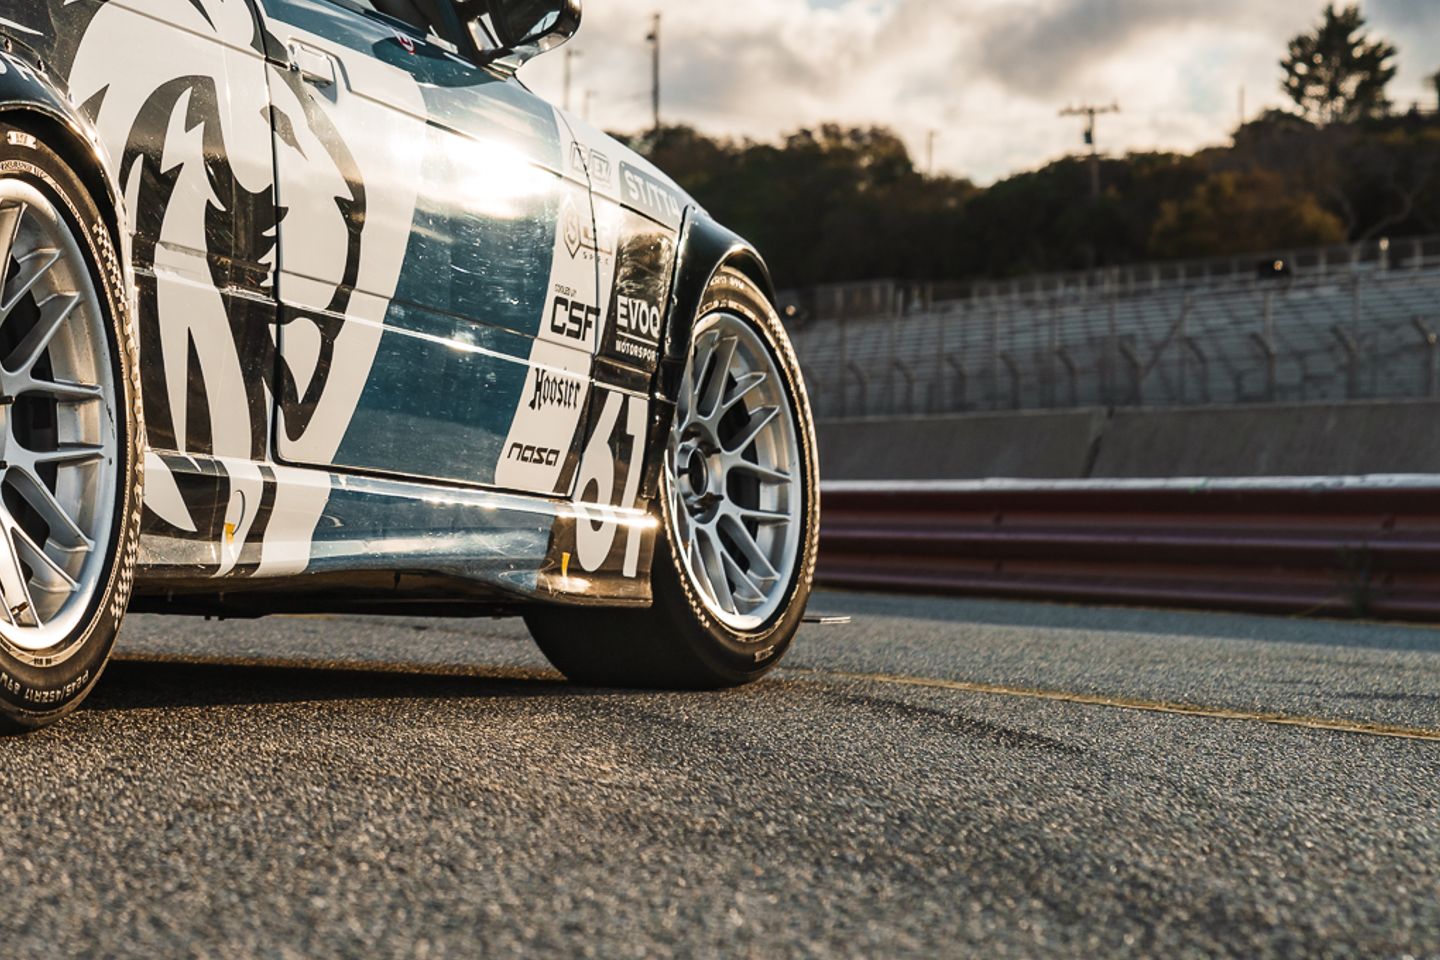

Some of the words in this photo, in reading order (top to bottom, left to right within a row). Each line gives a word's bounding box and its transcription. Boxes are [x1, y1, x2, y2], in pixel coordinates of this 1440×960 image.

[551, 295, 601, 341] CSF
[617, 294, 661, 339] EVOQ
[529, 367, 581, 411] Hoosier
[574, 391, 649, 578] 61
